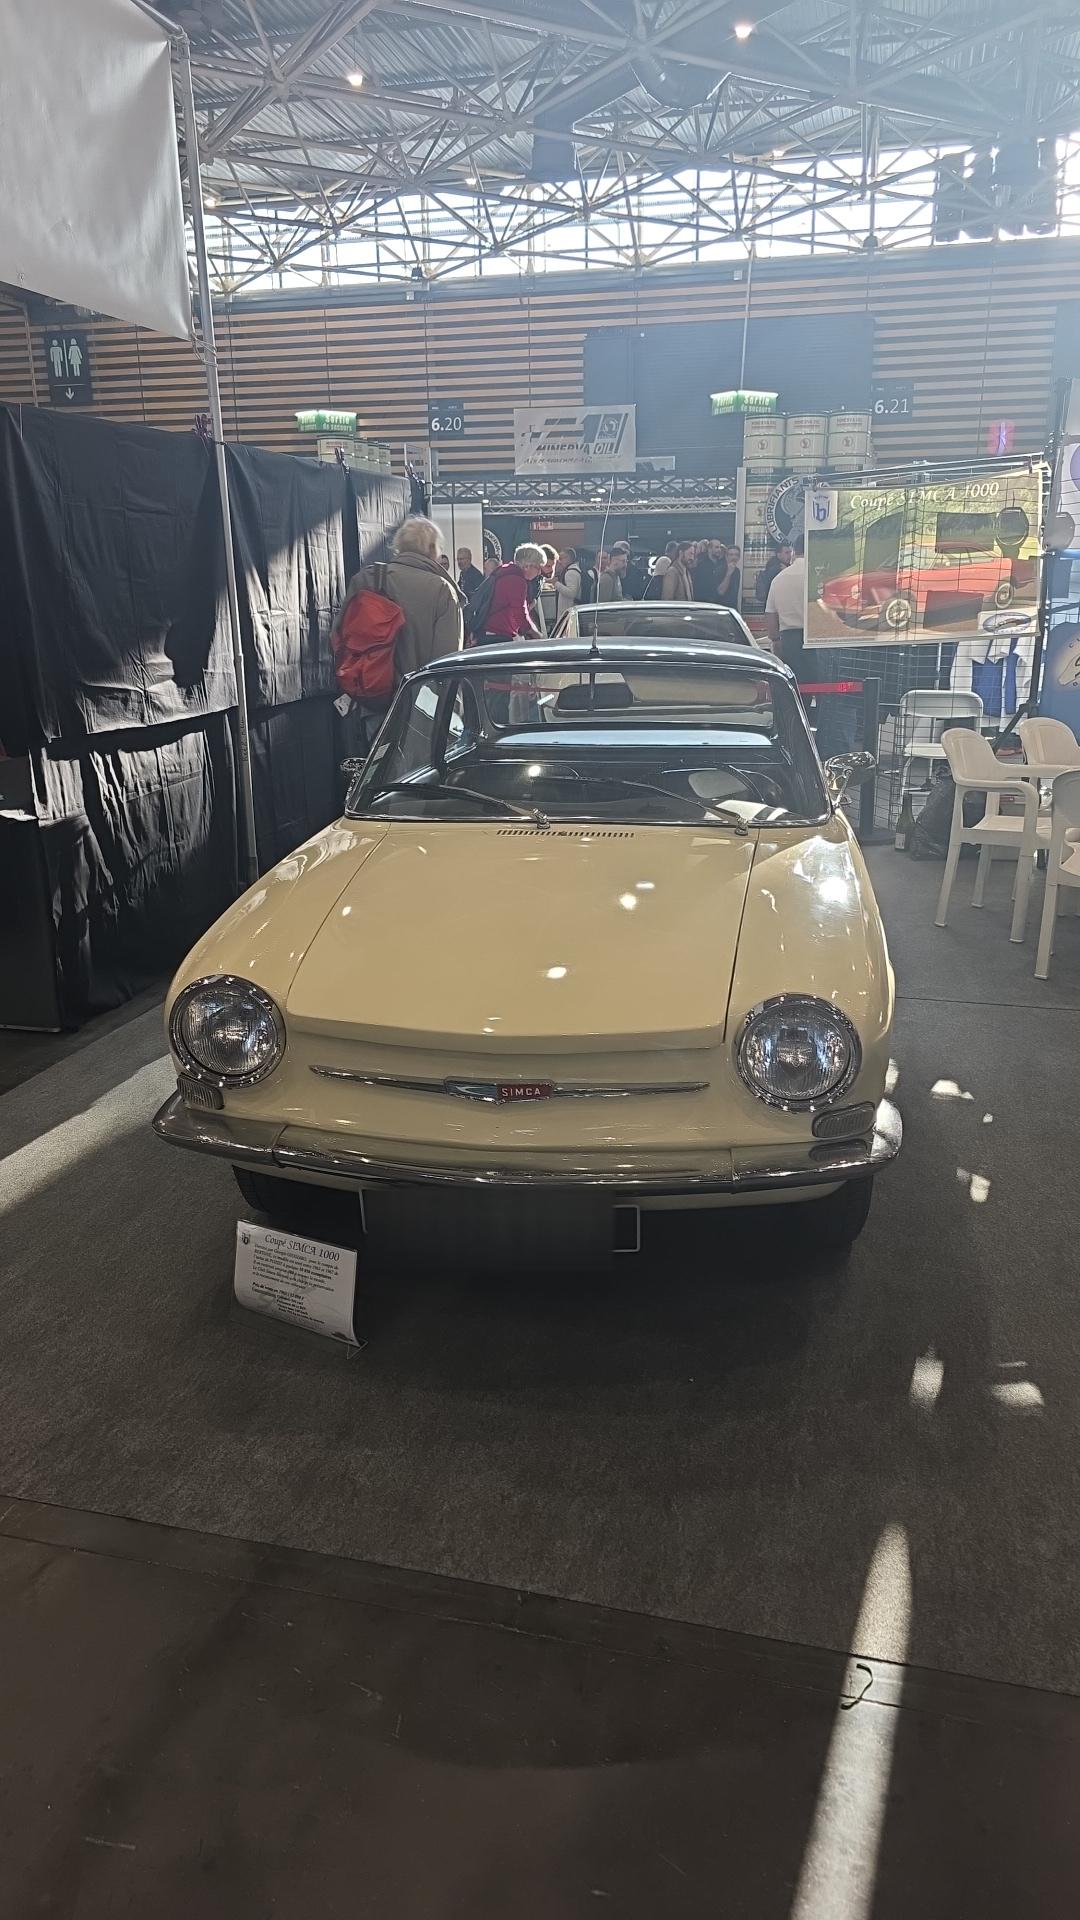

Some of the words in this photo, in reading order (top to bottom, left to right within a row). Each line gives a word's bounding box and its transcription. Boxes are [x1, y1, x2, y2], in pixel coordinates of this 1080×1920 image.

[744, 395, 771, 406] Sortie
[875, 398, 909, 414] 6.21
[431, 416, 462, 431] 6.20
[594, 442, 616, 455] OIL
[850, 493, 895, 510] Coupé
[897, 487, 956, 506] SIMCA
[962, 482, 1000, 499] 1000
[767, 479, 799, 533] LUBRIFIANTS
[501, 1087, 541, 1097] SIMCA
[265, 1234, 286, 1249] Coupé
[287, 1240, 317, 1255] SIMCA
[319, 1249, 340, 1261] 1000
